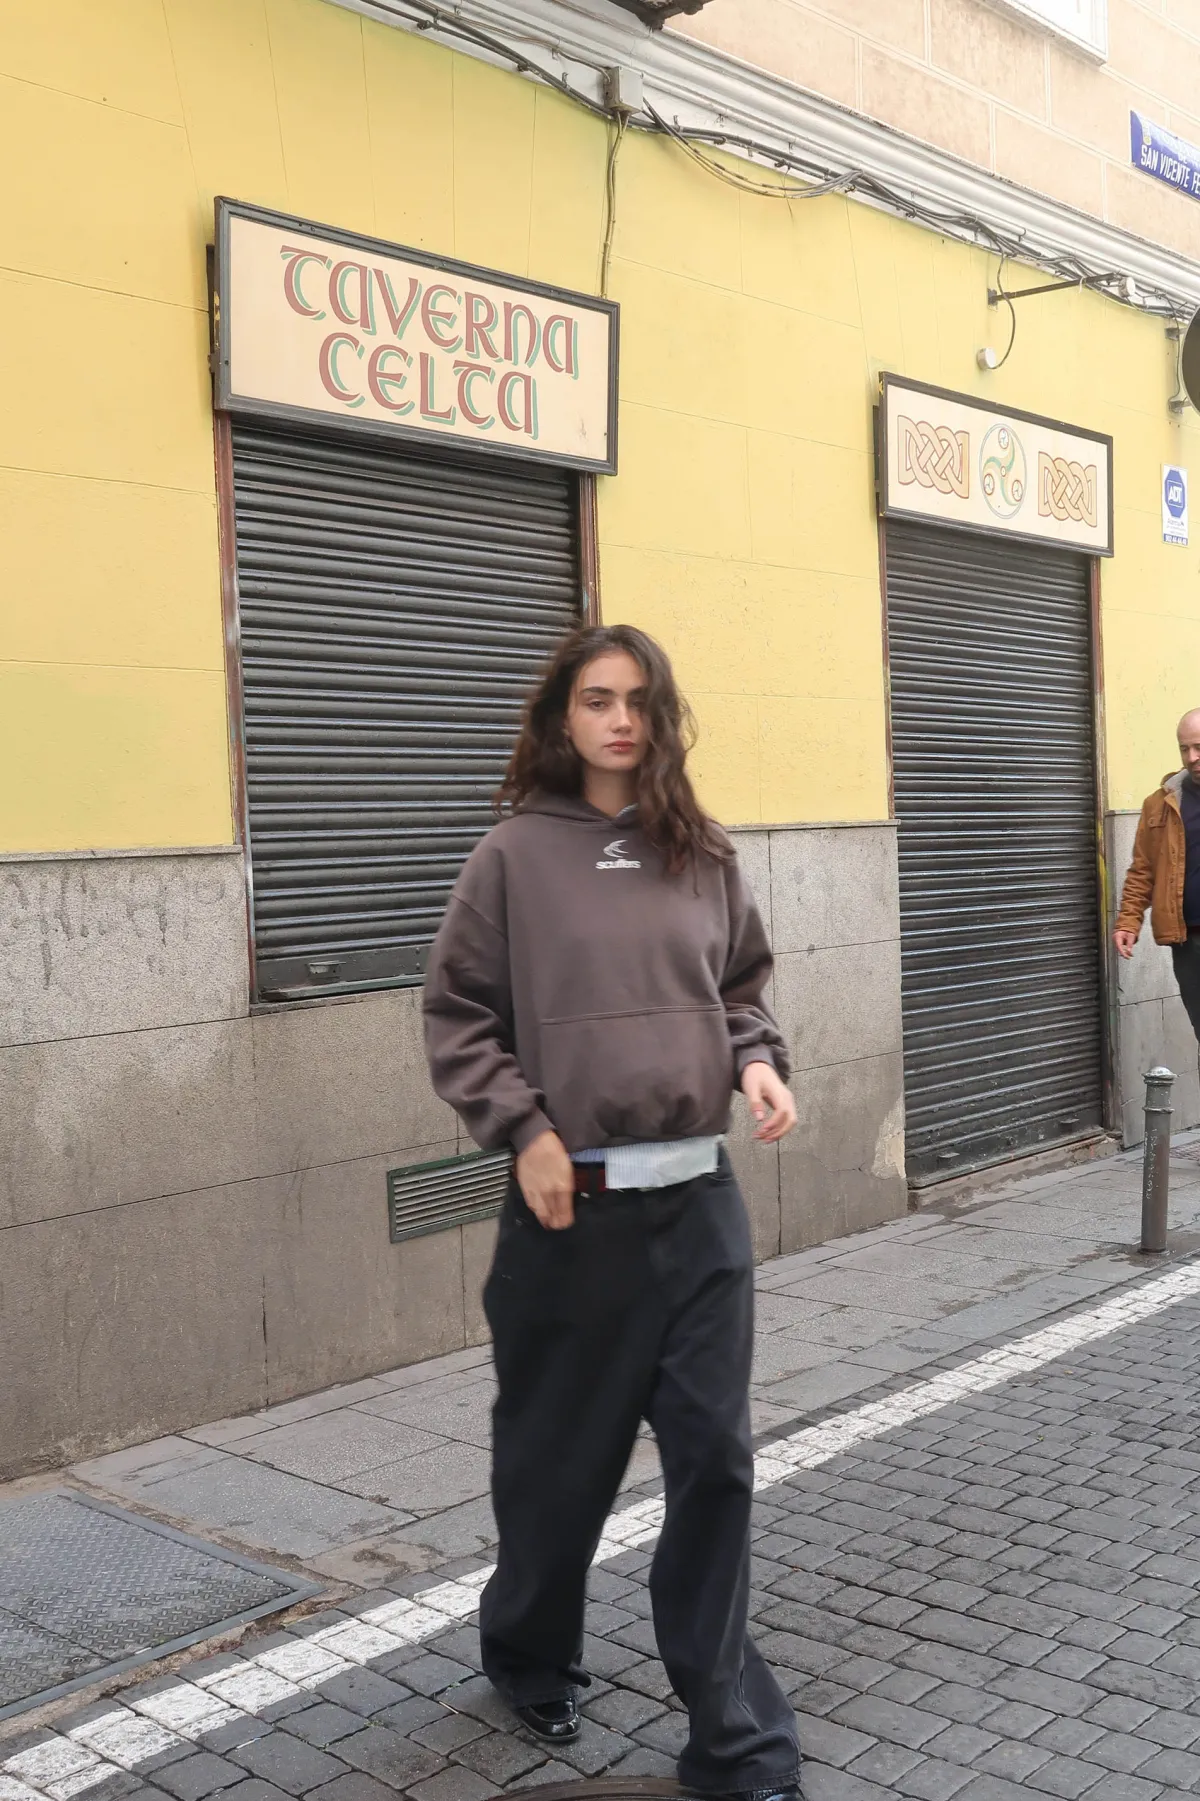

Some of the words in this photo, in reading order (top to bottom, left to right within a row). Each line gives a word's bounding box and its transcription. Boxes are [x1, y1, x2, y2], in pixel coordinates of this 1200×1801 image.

[1140, 144, 1159, 172] SAN
[1159, 153, 1191, 188] VICENTE
[280, 244, 579, 380] TAVERNA
[318, 332, 539, 441] CELTA
[1168, 485, 1183, 504] ADT
